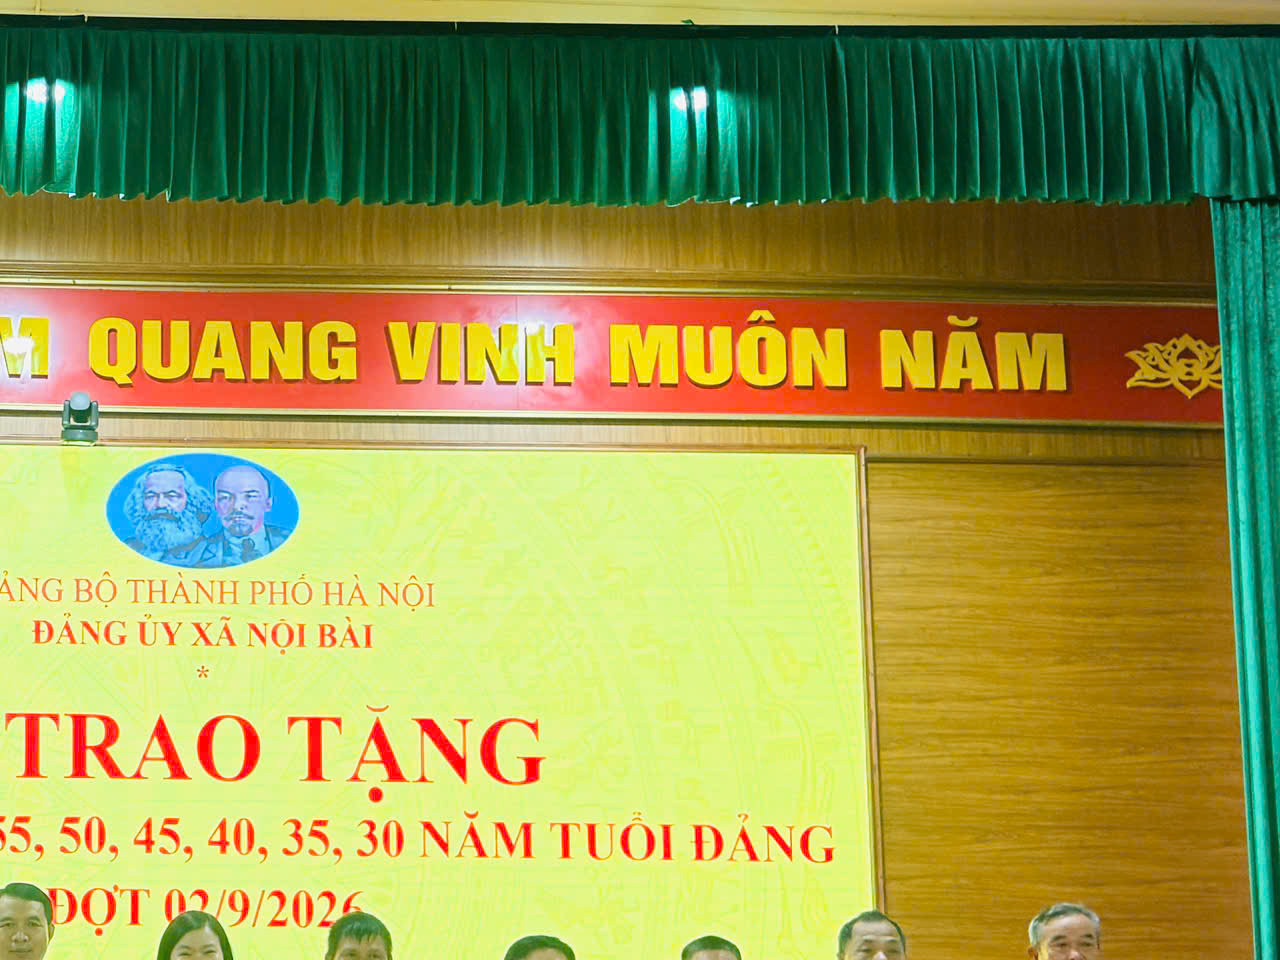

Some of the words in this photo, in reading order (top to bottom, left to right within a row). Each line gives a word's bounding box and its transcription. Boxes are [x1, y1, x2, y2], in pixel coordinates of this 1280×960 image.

[87, 315, 359, 387] QUANG
[386, 320, 576, 386] VINH
[608, 309, 848, 389] MUÔN
[879, 315, 1069, 392] NĂM
[74, 571, 118, 608] BỘ
[126, 572, 238, 605] THÀNH
[249, 573, 313, 606] PHỐ
[322, 574, 369, 607] HÀ
[378, 575, 435, 612] NỘI
[31, 612, 128, 646] ĐẢNG
[138, 613, 183, 647] ỦY
[191, 616, 237, 647] XÃ
[247, 618, 306, 655] NỘI
[318, 616, 374, 649] BÀI
[4, 711, 263, 783] TRAO
[286, 704, 548, 804] TẶNG
[59, 816, 119, 862] 50,
[133, 817, 194, 862] 45,
[208, 818, 269, 863] 40,
[281, 818, 343, 863] 35,
[356, 819, 405, 858] 30
[418, 810, 536, 859] NĂM
[549, 811, 676, 861] TUỔI
[689, 813, 837, 863] ĐẢNG
[47, 884, 151, 936] ĐỢT
